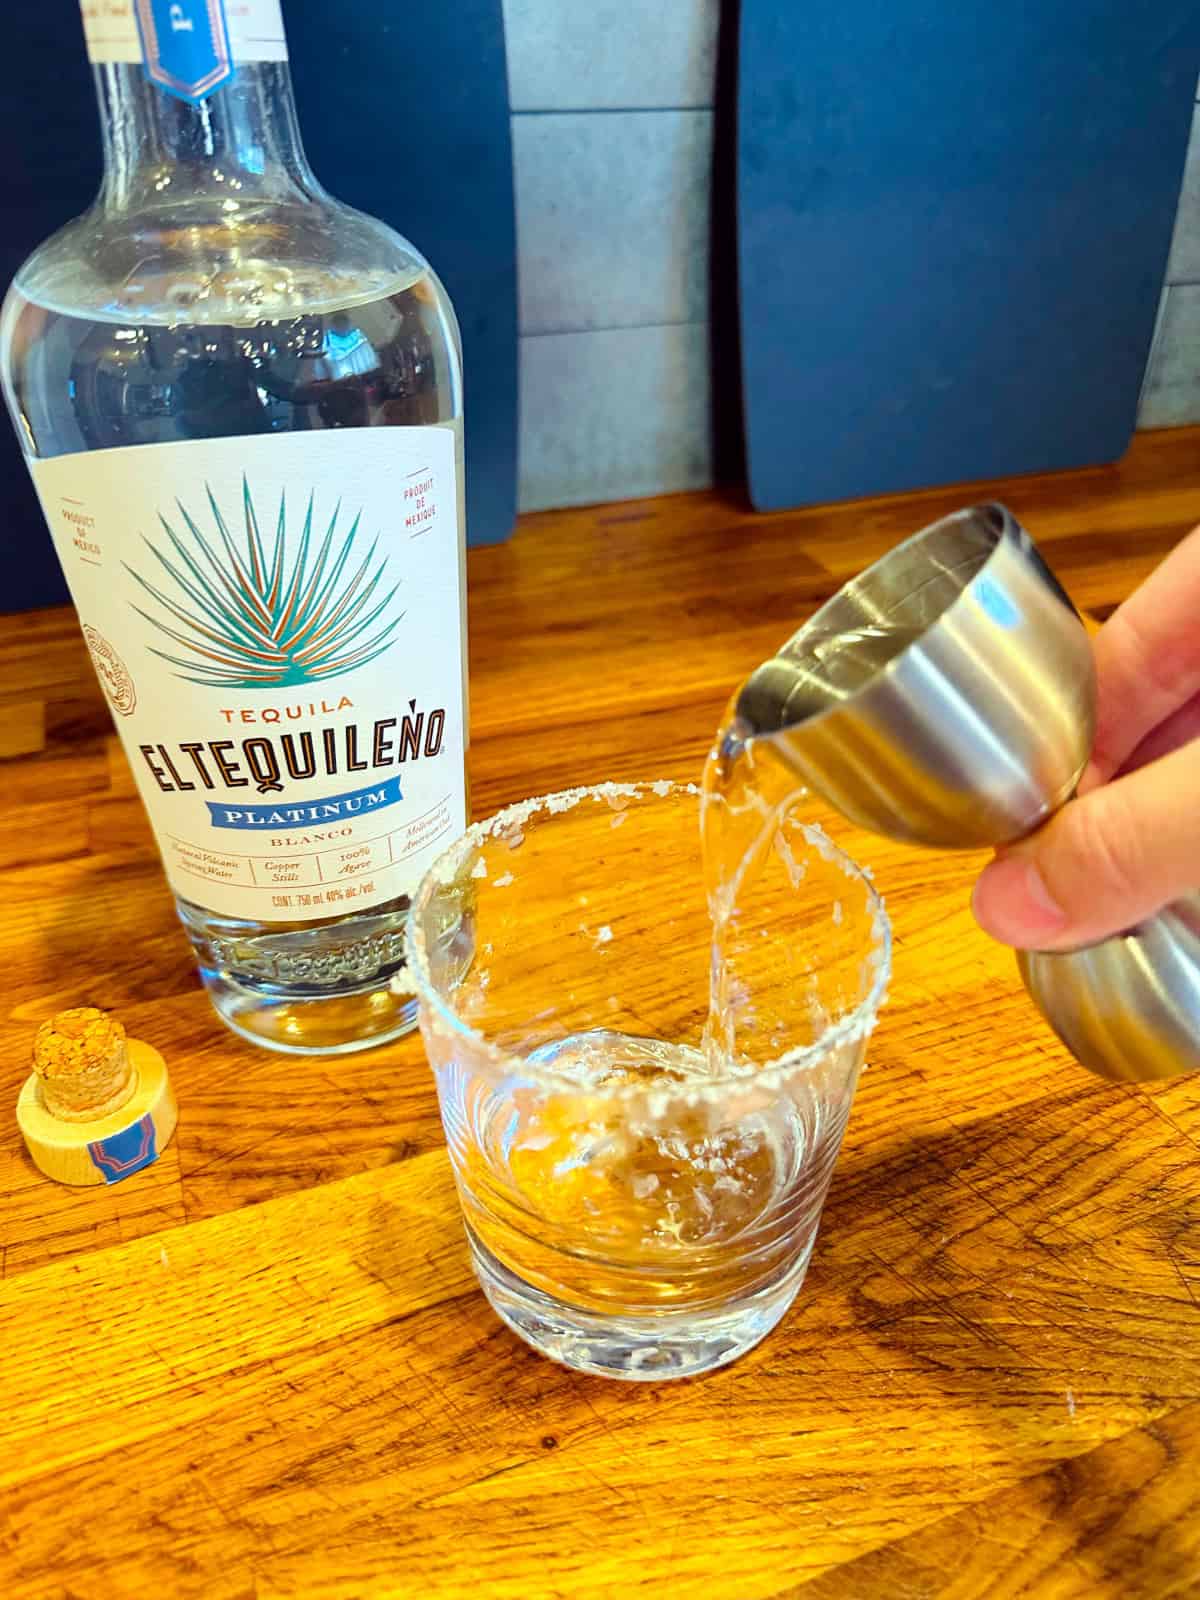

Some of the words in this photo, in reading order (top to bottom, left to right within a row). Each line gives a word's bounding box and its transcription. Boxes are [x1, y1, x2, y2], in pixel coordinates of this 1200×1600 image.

[220, 696, 354, 723] TEQUILA
[224, 789, 388, 825] PLATINUM
[270, 828, 353, 847] BLANCO
[338, 847, 371, 862] 100%
[264, 861, 300, 872] Copper
